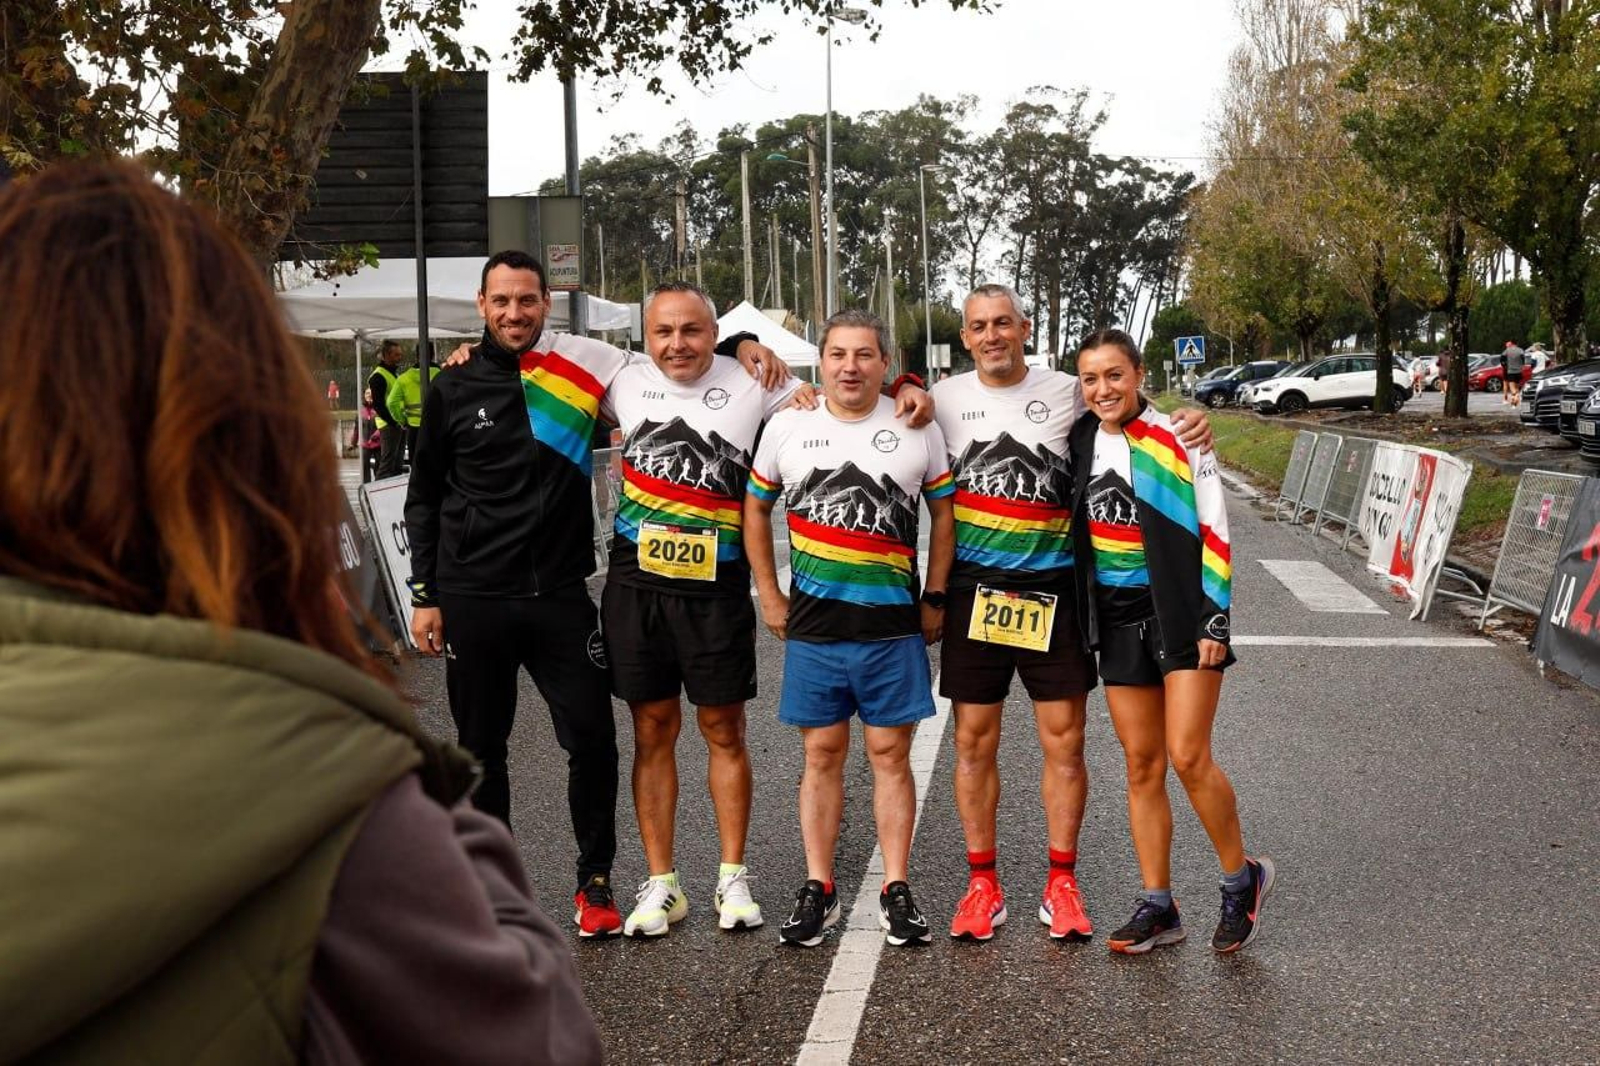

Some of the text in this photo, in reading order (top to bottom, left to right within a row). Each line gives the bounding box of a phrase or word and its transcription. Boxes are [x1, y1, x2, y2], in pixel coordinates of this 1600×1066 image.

[648, 538, 706, 564] 2020
[1550, 573, 1576, 628] LA
[982, 602, 1040, 632] 2011
